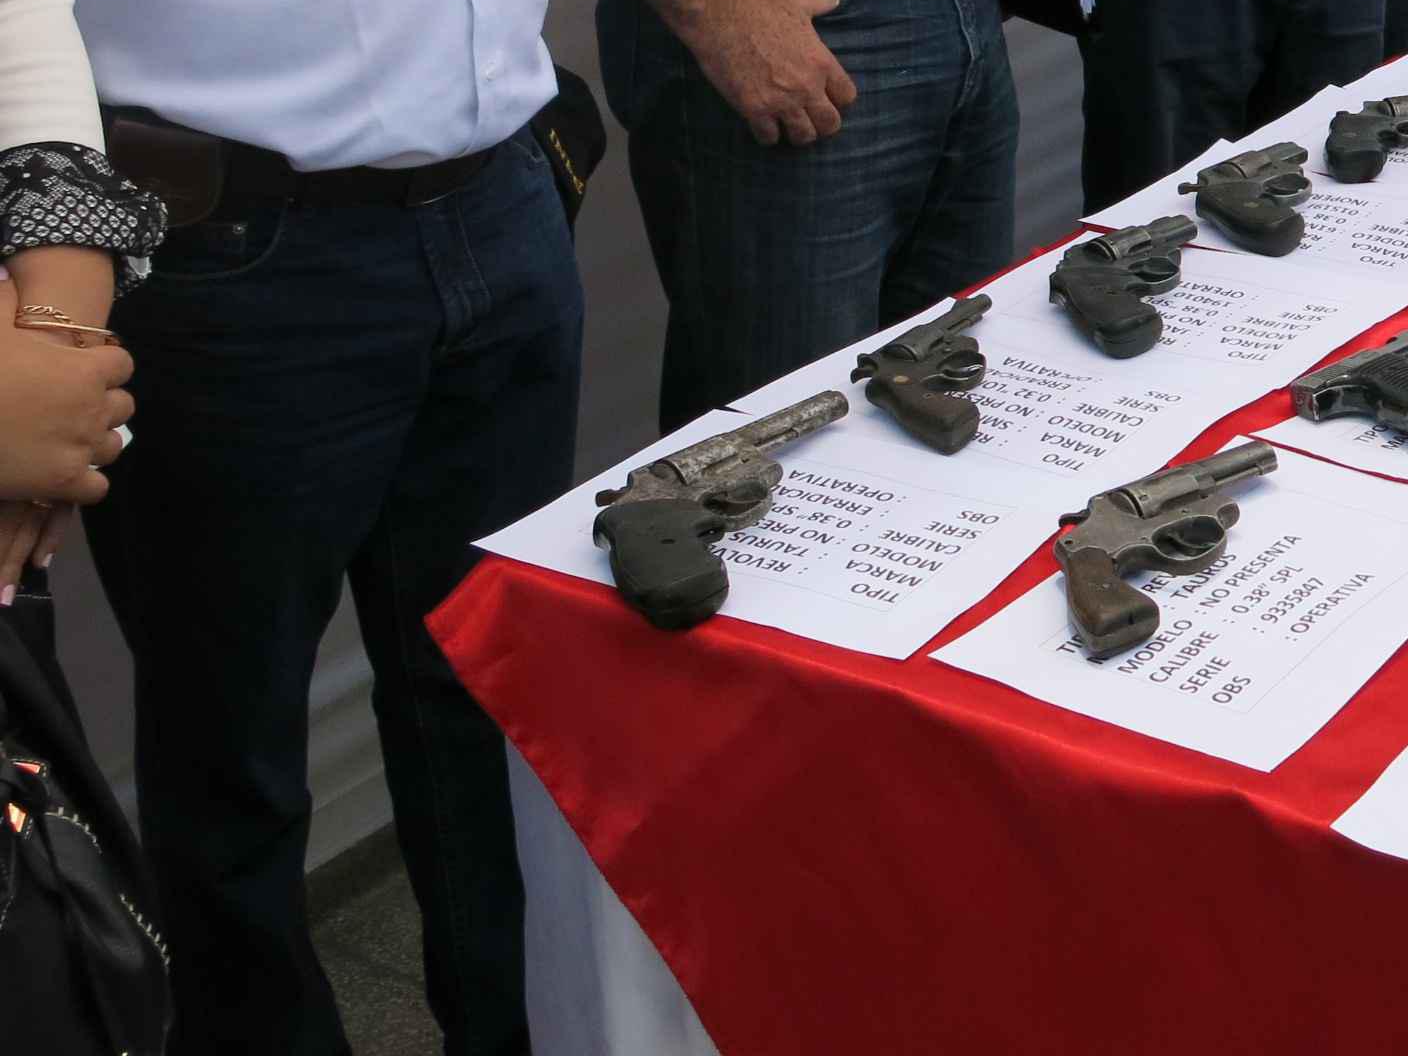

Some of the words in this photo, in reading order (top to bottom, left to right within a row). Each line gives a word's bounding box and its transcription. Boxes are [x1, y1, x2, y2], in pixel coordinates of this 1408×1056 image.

[1351, 242, 1408, 260] MARCA
[1359, 255, 1395, 267] TIPO
[1281, 311, 1322, 321] SERIE
[1303, 304, 1338, 313] OBS
[1178, 317, 1206, 326] NO
[1245, 316, 1311, 330] CALIBRE
[1221, 325, 1297, 340] MODELO
[1220, 336, 1282, 350] MARCA
[1227, 350, 1267, 361] TIPO
[1113, 396, 1159, 412] SERIE
[1144, 390, 1181, 402] OBS
[1004, 404, 1035, 417] NO
[1072, 402, 1143, 427] CALIBRE
[1047, 415, 1125, 443] MODELO
[1040, 432, 1106, 457] MARCA
[1042, 453, 1084, 471] TIPO
[788, 470, 893, 501] OPERATIVA
[957, 510, 999, 524] OBS
[799, 529, 834, 544] NO
[925, 520, 981, 539] SERIE
[728, 528, 808, 557] TAURUS
[878, 529, 961, 554] CALIBRE
[851, 543, 942, 571] MODELO
[845, 559, 922, 587] MARCA
[1170, 553, 1236, 599] TAURUS
[850, 583, 899, 603] TIPO
[1118, 620, 1192, 673] MODELO
[1199, 588, 1230, 608] NO
[1224, 535, 1300, 587] PRESENTA
[1149, 631, 1218, 682] CALIBRE
[1269, 565, 1303, 583] SPL
[1179, 656, 1230, 693] SERIE
[1260, 577, 1323, 623] 9335847
[1211, 676, 1251, 703] OBS
[1290, 574, 1373, 633] OPERATIVA
